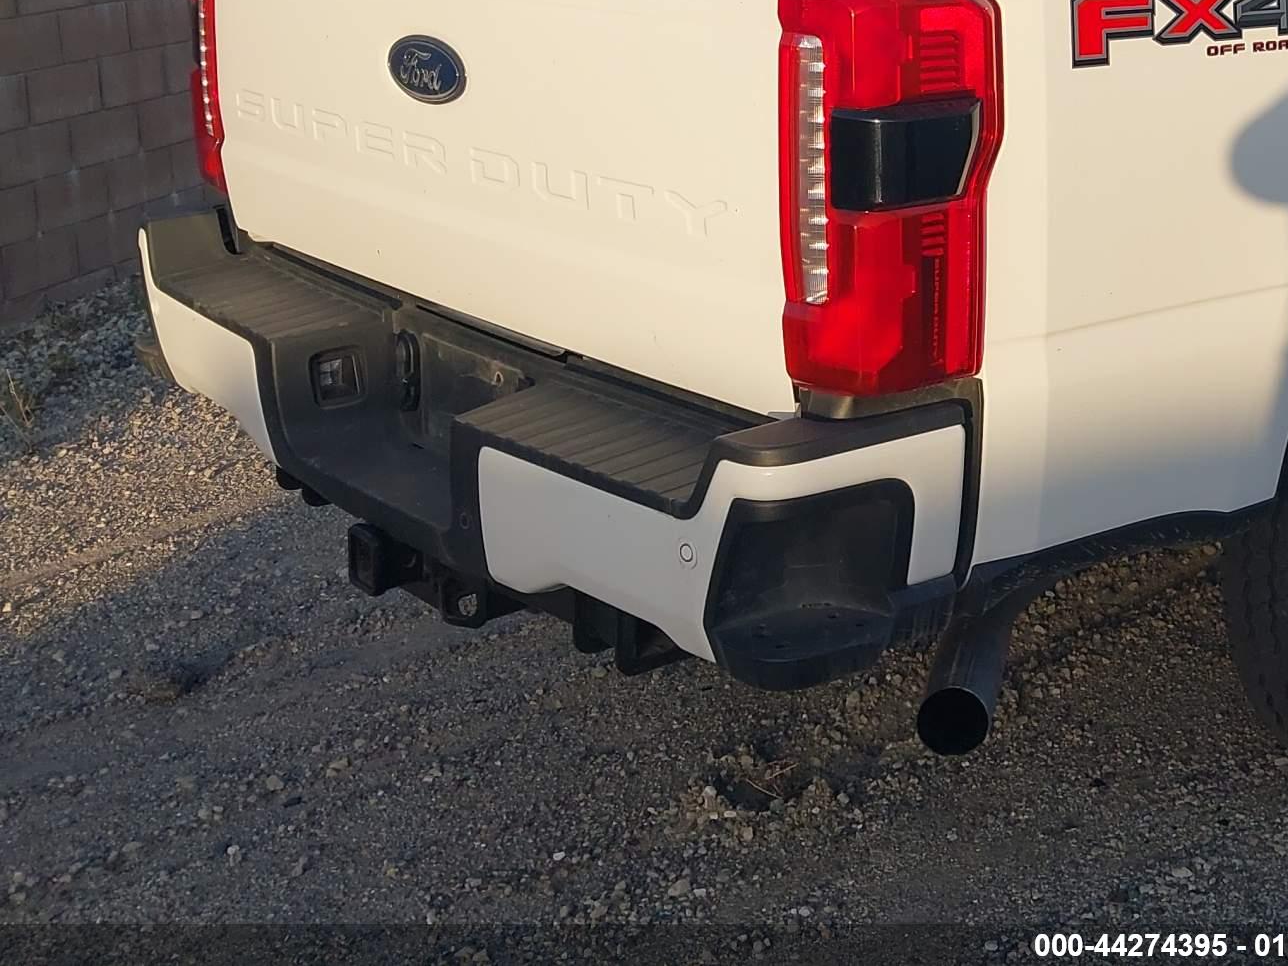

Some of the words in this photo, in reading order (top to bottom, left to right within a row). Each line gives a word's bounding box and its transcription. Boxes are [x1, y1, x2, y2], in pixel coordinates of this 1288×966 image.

[400, 48, 442, 91] Ford
[1206, 43, 1246, 56] OFF
[234, 89, 448, 174] SUPER
[468, 146, 729, 236] DUTY
